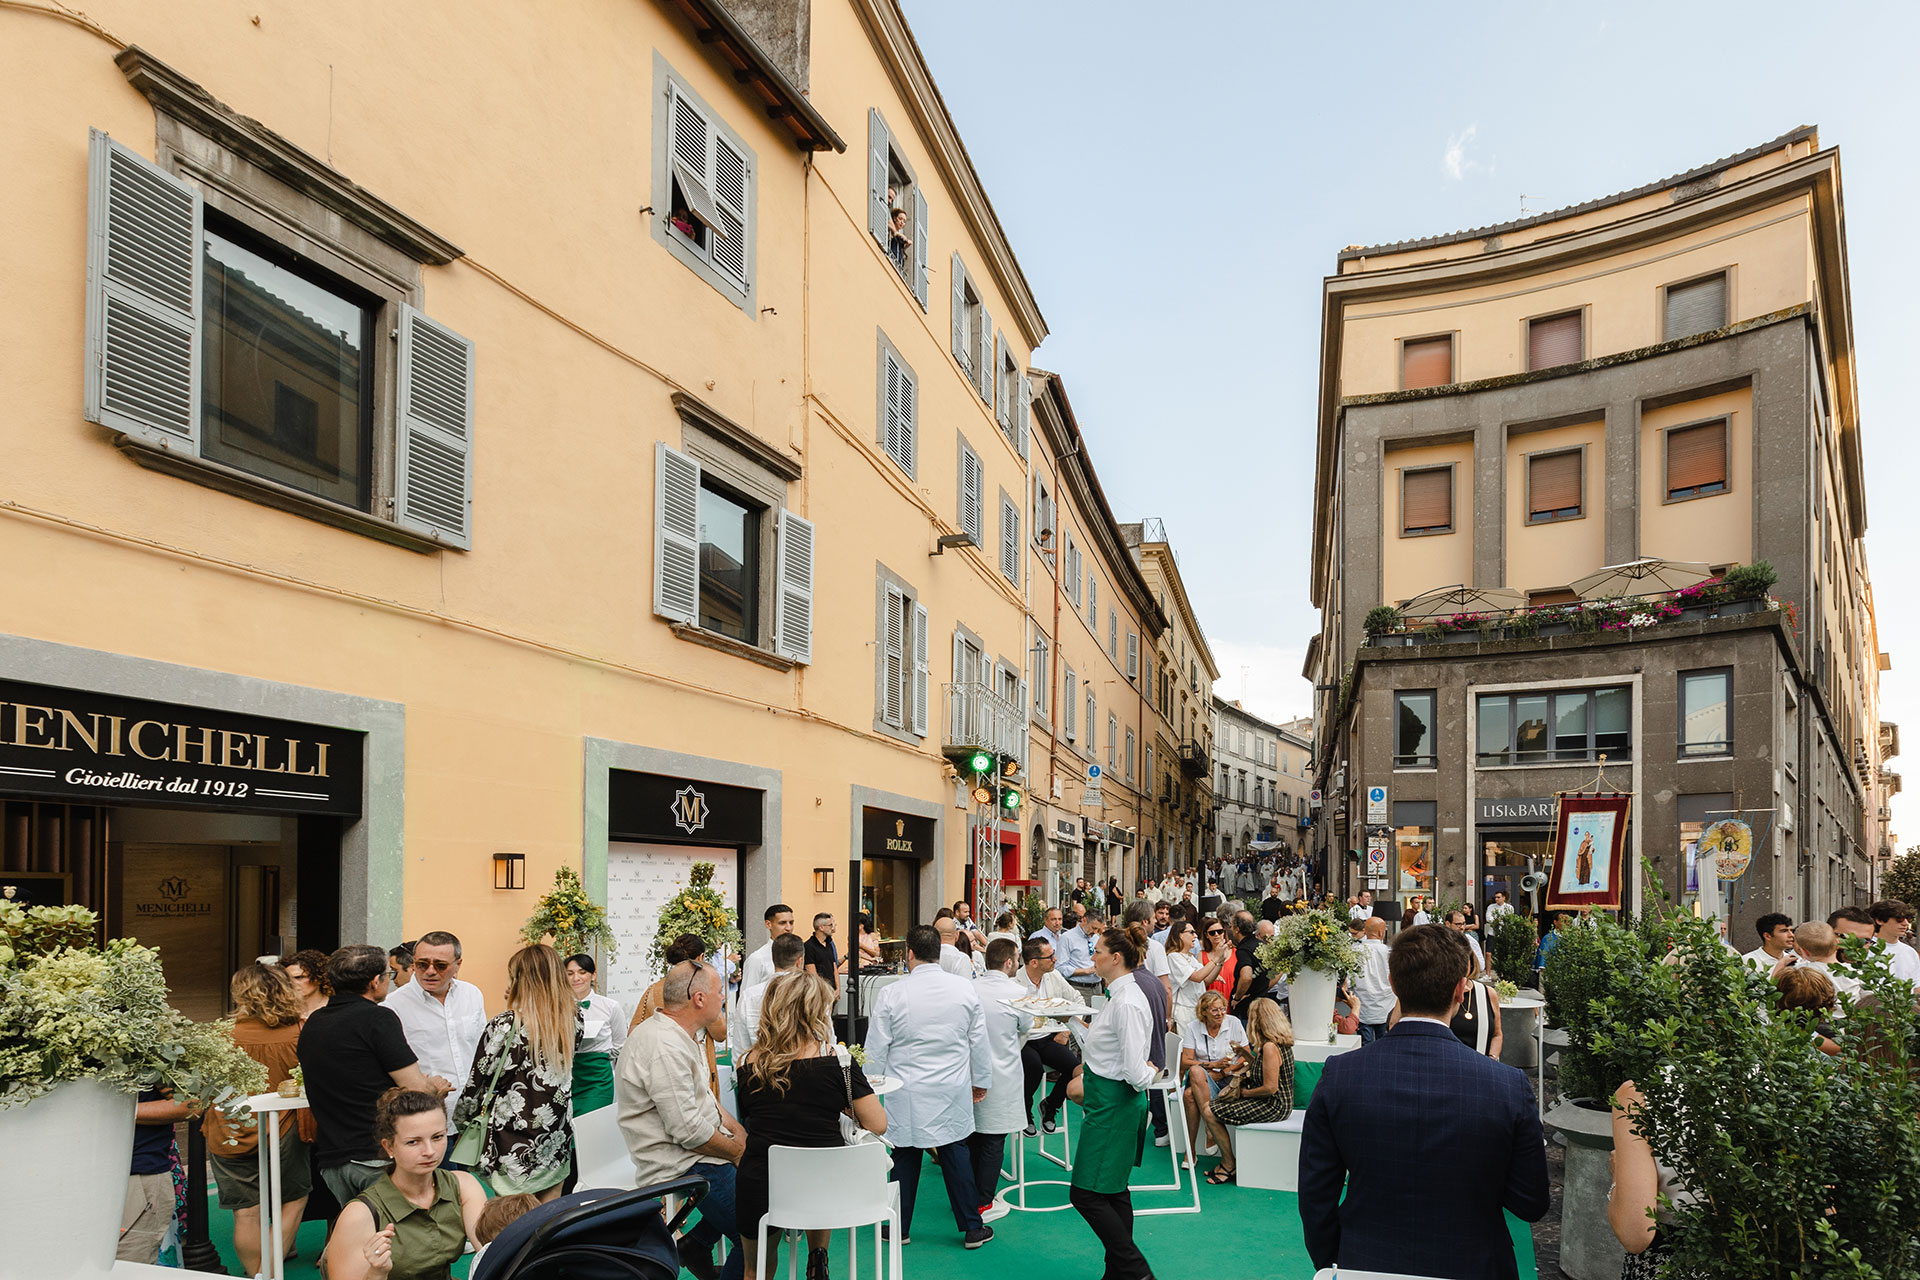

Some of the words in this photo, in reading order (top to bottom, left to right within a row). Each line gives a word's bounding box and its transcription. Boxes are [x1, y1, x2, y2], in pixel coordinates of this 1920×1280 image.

[0, 701, 331, 778] ENICHELLI
[65, 767, 165, 791] Gioiellieri
[165, 776, 199, 794] dal
[200, 780, 249, 798] 1912
[679, 795, 702, 824] M
[886, 838, 913, 852] ROLEX
[136, 903, 211, 913] MENICHELLI
